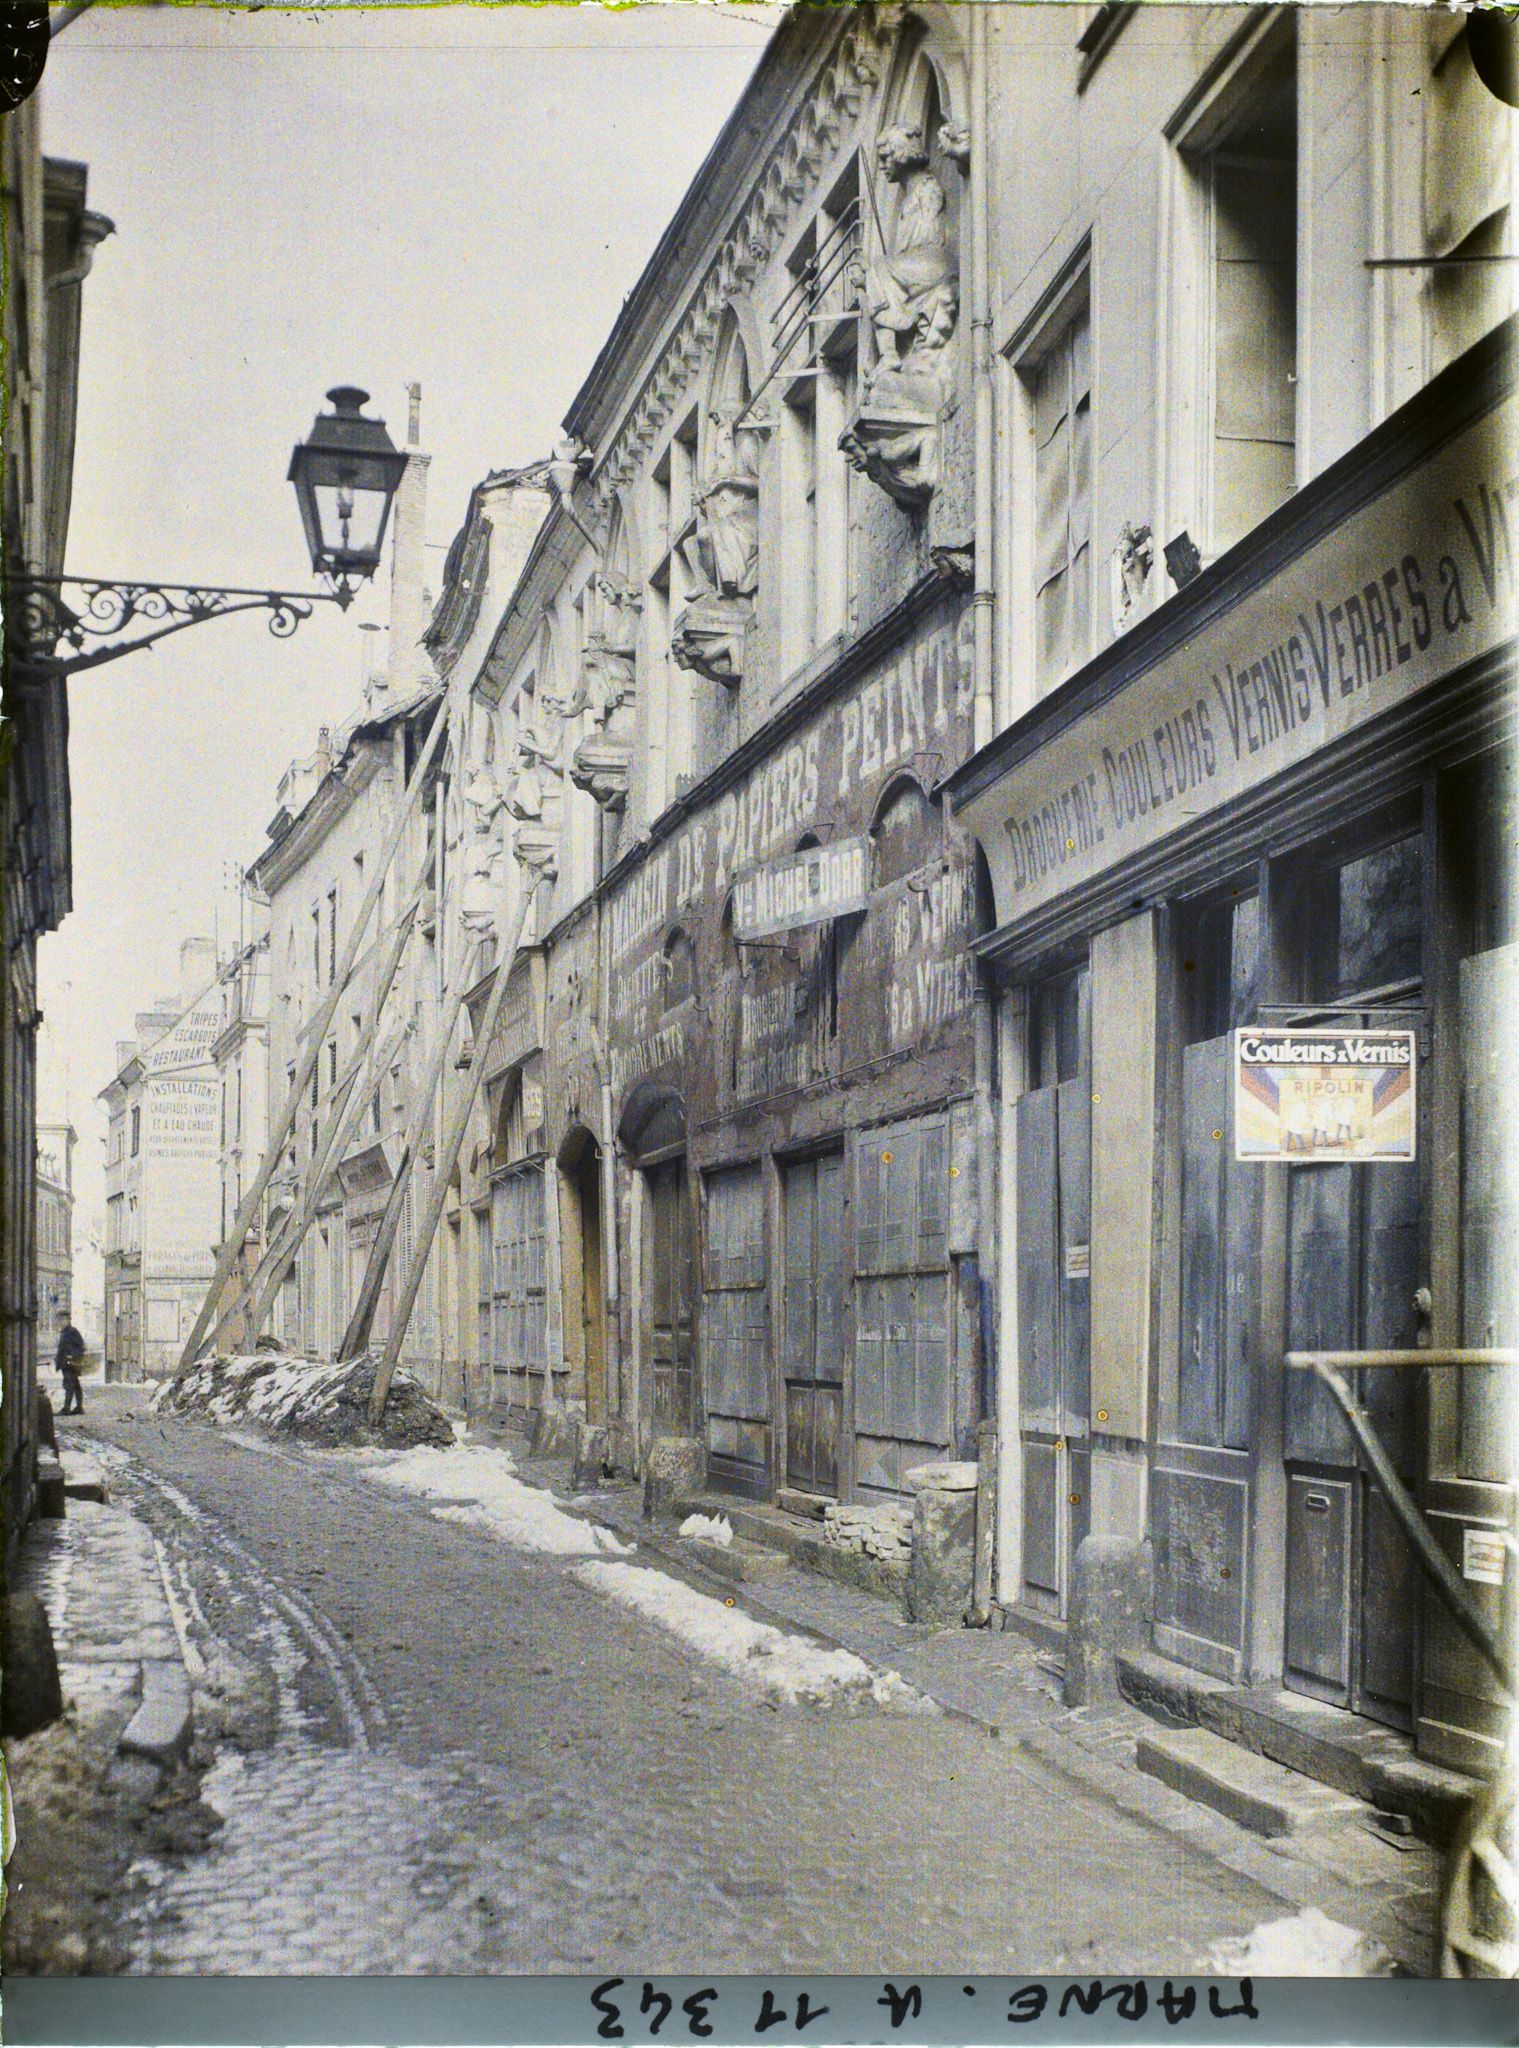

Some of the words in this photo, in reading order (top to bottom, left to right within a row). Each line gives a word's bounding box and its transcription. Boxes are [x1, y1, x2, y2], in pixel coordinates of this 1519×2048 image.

[1003, 773, 1104, 892] DROGUERIE
[1102, 702, 1215, 829] COULEURS
[1213, 636, 1311, 761] VERNIS
[1300, 554, 1431, 708] VERRES
[676, 825, 708, 908] DE
[715, 726, 820, 889] PAPIERS
[838, 607, 976, 797] PEINTS
[190, 1012, 218, 1026] TRIPES
[175, 1028, 217, 1043] ESCARGOTS
[153, 1046, 206, 1066] RESTAURANT
[1240, 1038, 1336, 1063] Couleurs
[1343, 1039, 1410, 1064] Vernis
[150, 1082, 218, 1099] INSTALLATIONS
[1294, 1081, 1364, 1095] RIPOLIN
[194, 1103, 217, 1115] VAPEUR
[153, 1118, 160, 1130] ET
[171, 1119, 185, 1131] EAU
[188, 1120, 214, 1131] CHAUDE
[1008, 1977, 1259, 2024] MARNE
